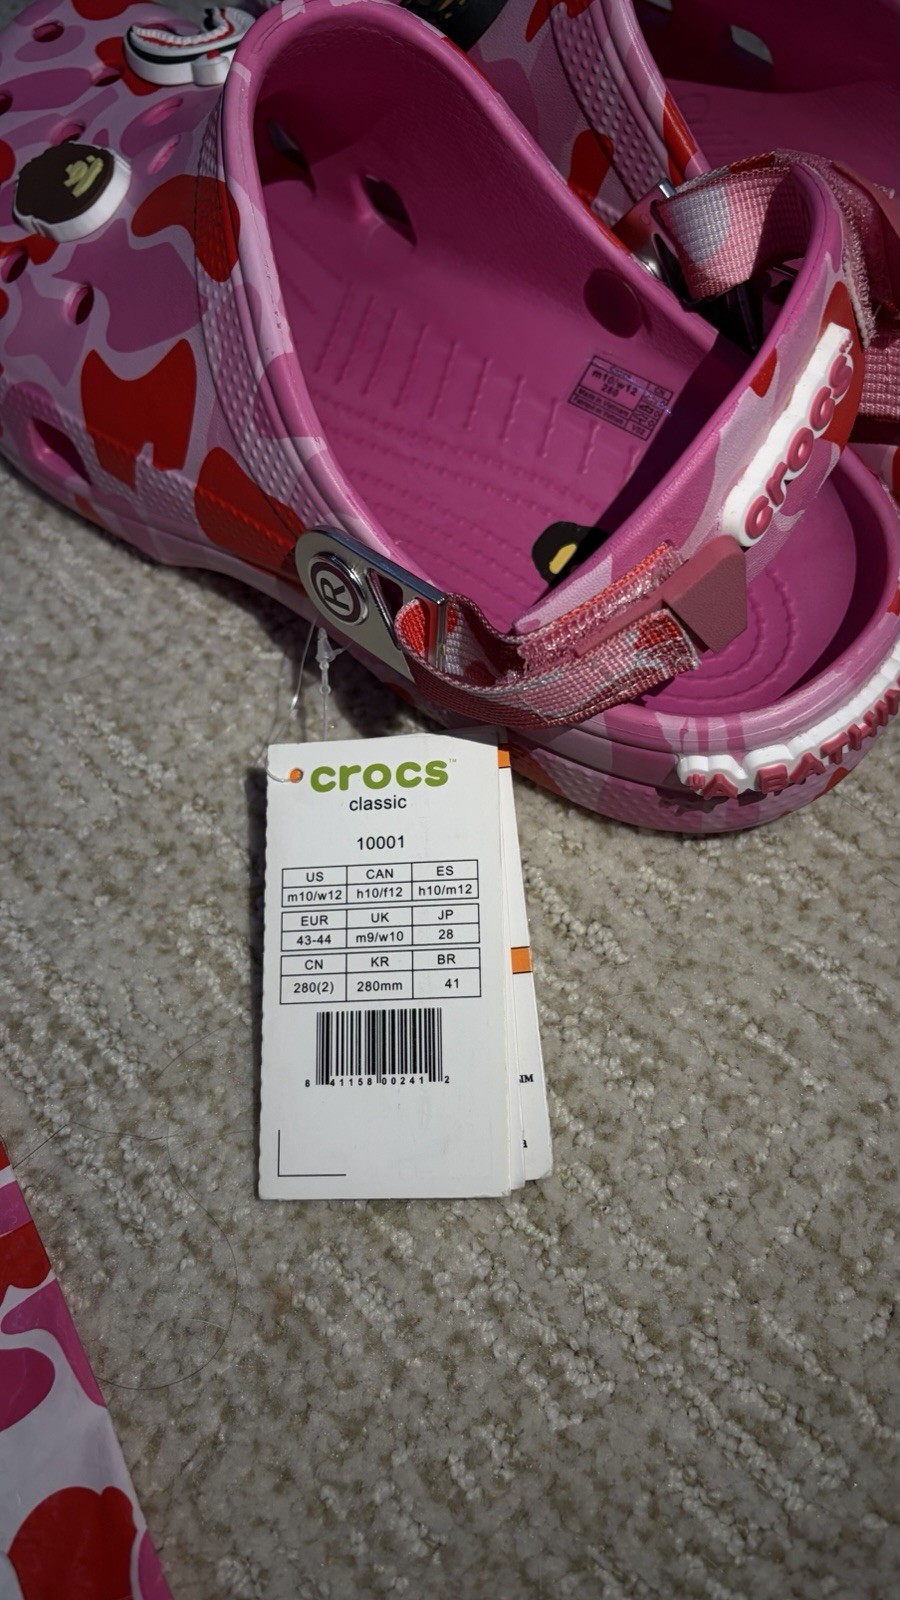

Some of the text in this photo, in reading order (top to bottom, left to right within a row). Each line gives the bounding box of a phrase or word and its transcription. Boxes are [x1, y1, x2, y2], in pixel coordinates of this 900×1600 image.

[744, 354, 853, 539] crocs
[310, 760, 449, 793] crocs
[348, 794, 408, 812] classic
[356, 834, 405, 851] 10001
[305, 865, 454, 883] US CAN ES
[287, 883, 473, 903] m10/w12 h10/f12 h10/m12
[300, 908, 454, 926] EUR UK JP
[296, 928, 454, 946] 43-44 m9/w10 28
[304, 953, 456, 971] CN KR BR
[293, 977, 459, 995] 280(2) 280mm 41
[304, 1079, 311, 1088] 8
[444, 1075, 450, 1084] 2
